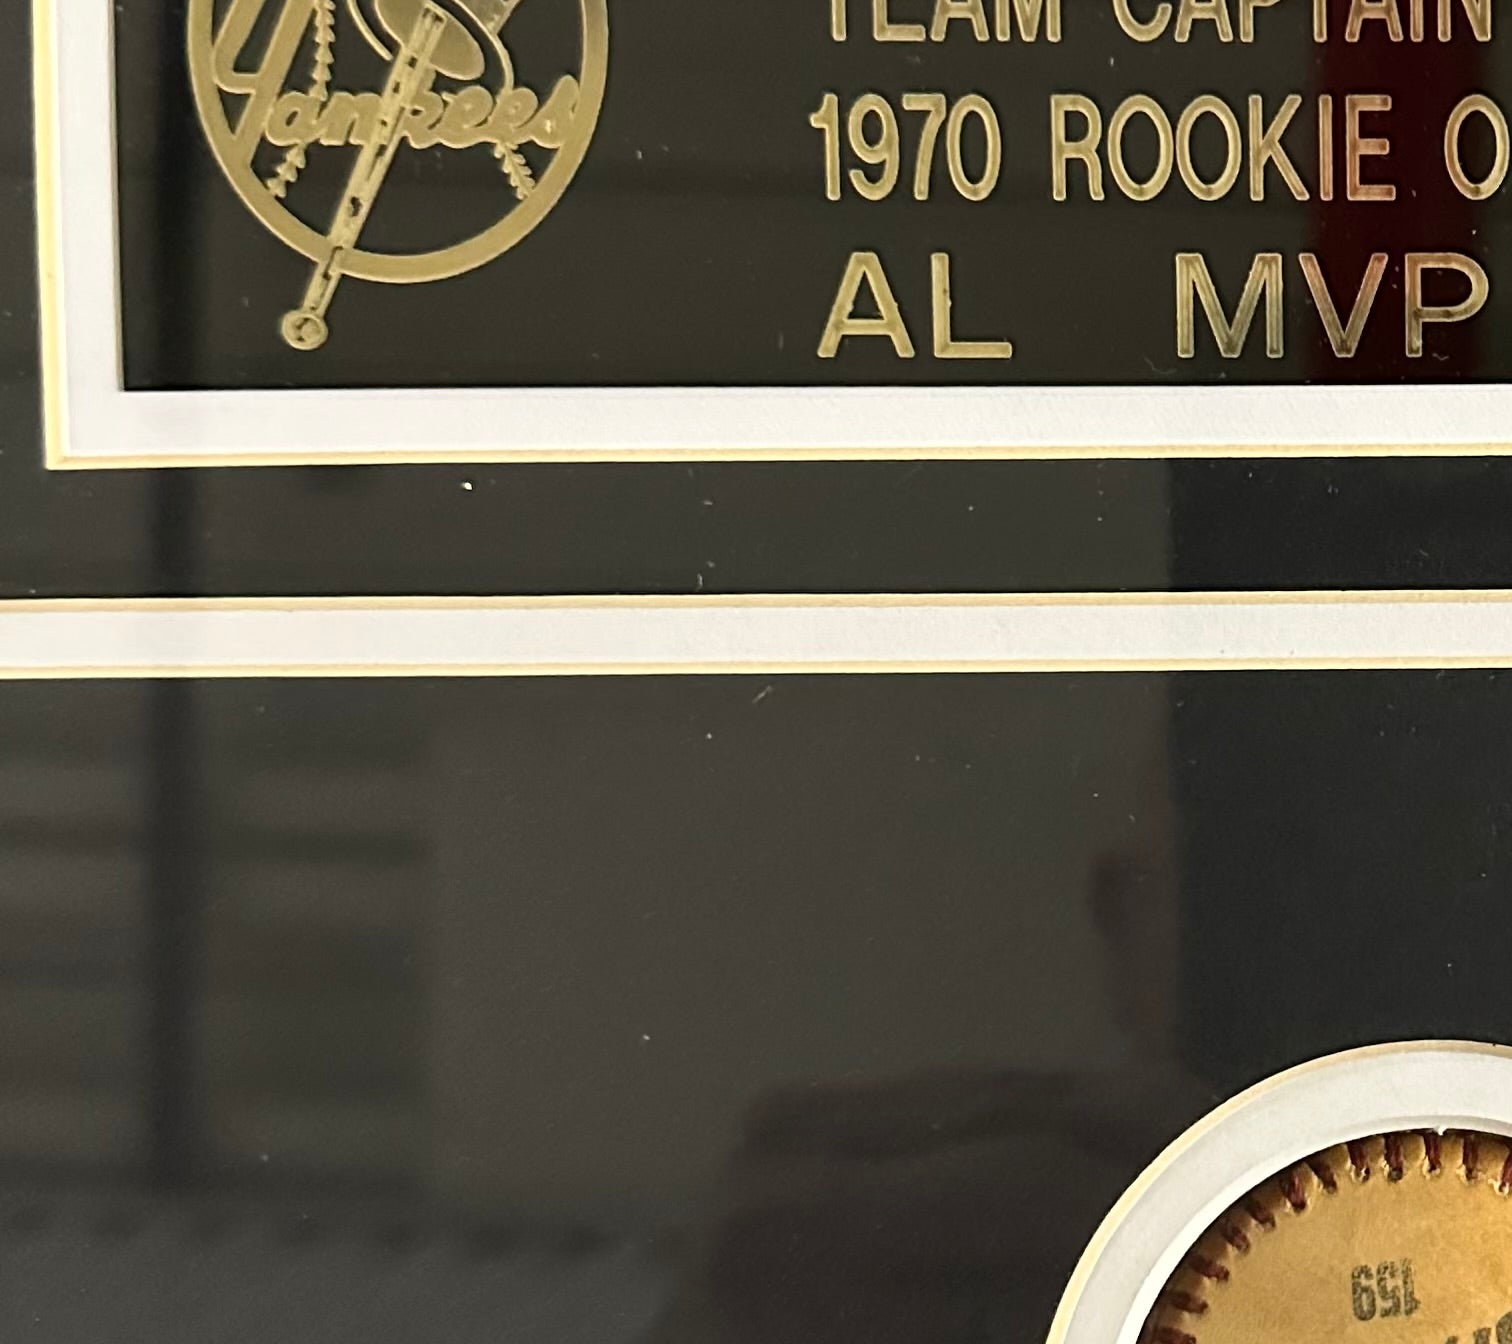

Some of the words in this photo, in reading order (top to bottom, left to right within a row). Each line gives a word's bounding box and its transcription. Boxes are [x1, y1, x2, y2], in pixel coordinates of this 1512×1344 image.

[807, 92, 1002, 202] 1970
[1049, 93, 1397, 202] ROOKIE
[816, 251, 1013, 359] AL
[1174, 252, 1490, 359] MVP
